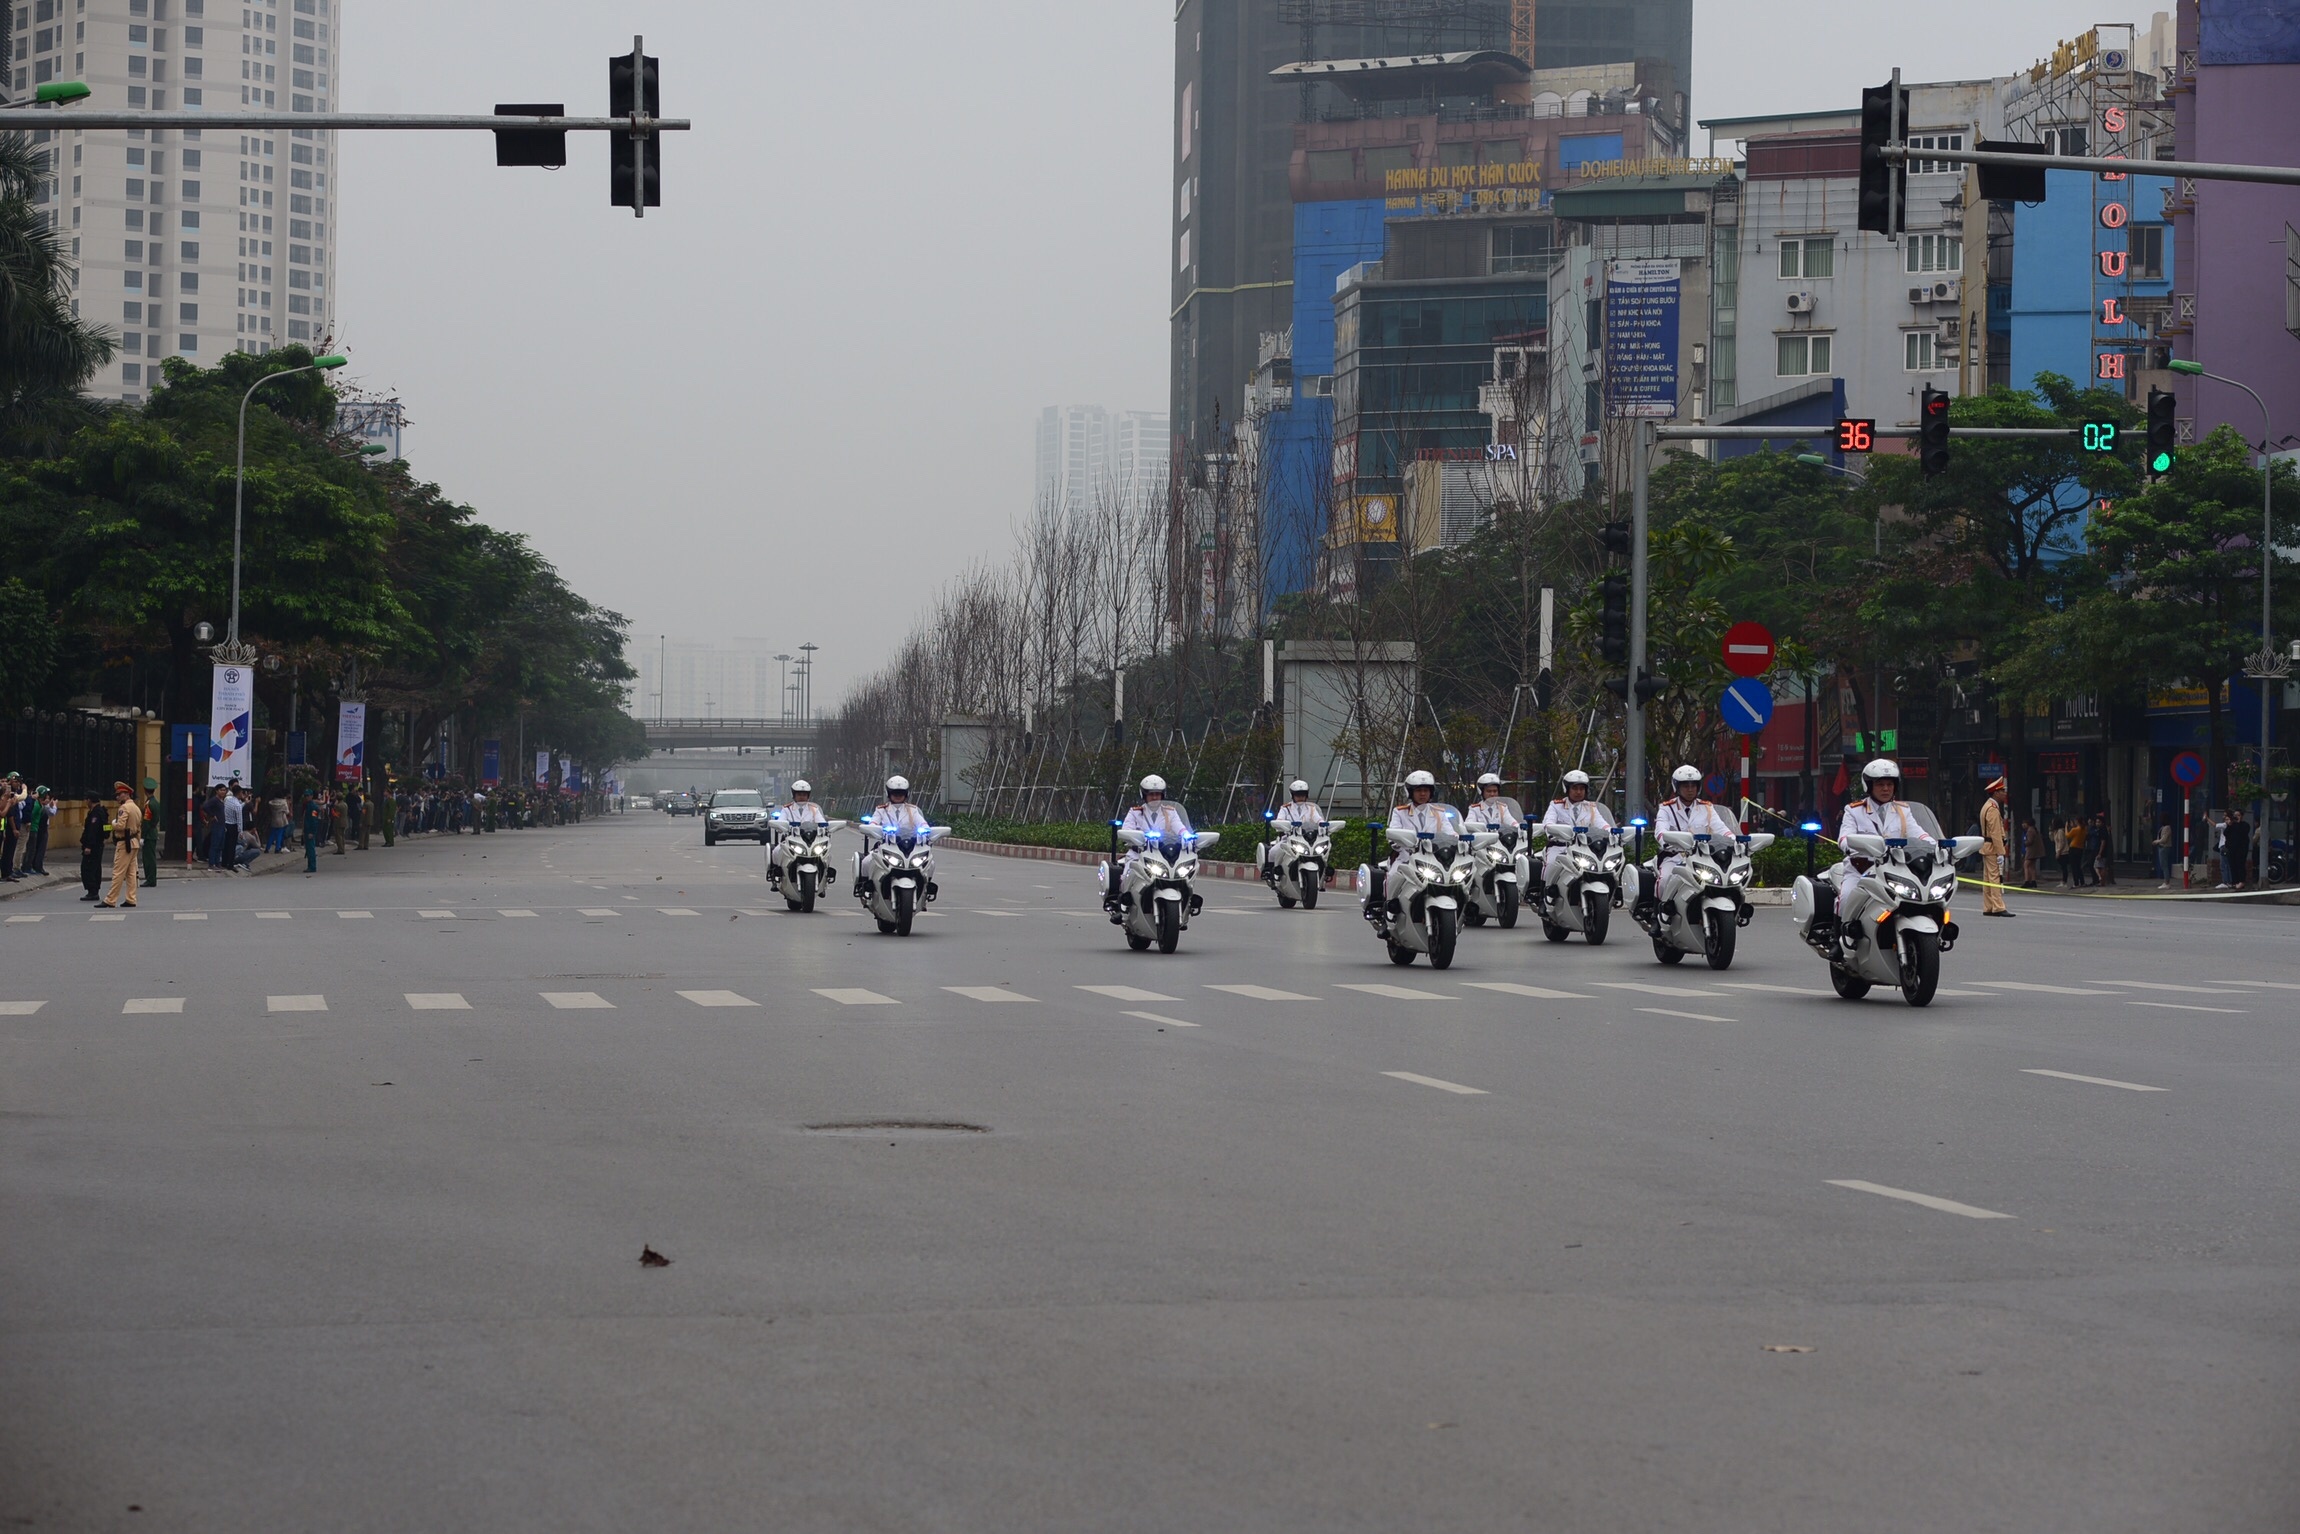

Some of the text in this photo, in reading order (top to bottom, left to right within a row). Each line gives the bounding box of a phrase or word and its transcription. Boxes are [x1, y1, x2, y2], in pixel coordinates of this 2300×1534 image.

[1386, 153, 1541, 192] HANNA DU HỌC HÀN QUỐC
[1581, 157, 1734, 178] DOHIEUAUTHENTIC.COM
[1385, 196, 1416, 210] HANNA
[1660, 296, 1676, 304] BƯỚU
[1644, 307, 1652, 316] VÀ
[1644, 342, 1660, 350] HỌNG
[1652, 352, 1666, 362] MẶT
[1658, 364, 1674, 372] KHÁC
[1660, 375, 1674, 384] VIỆN
[1840, 422, 1870, 449] 36
[2083, 423, 2115, 450] 02
[1485, 444, 1517, 461] SPA
